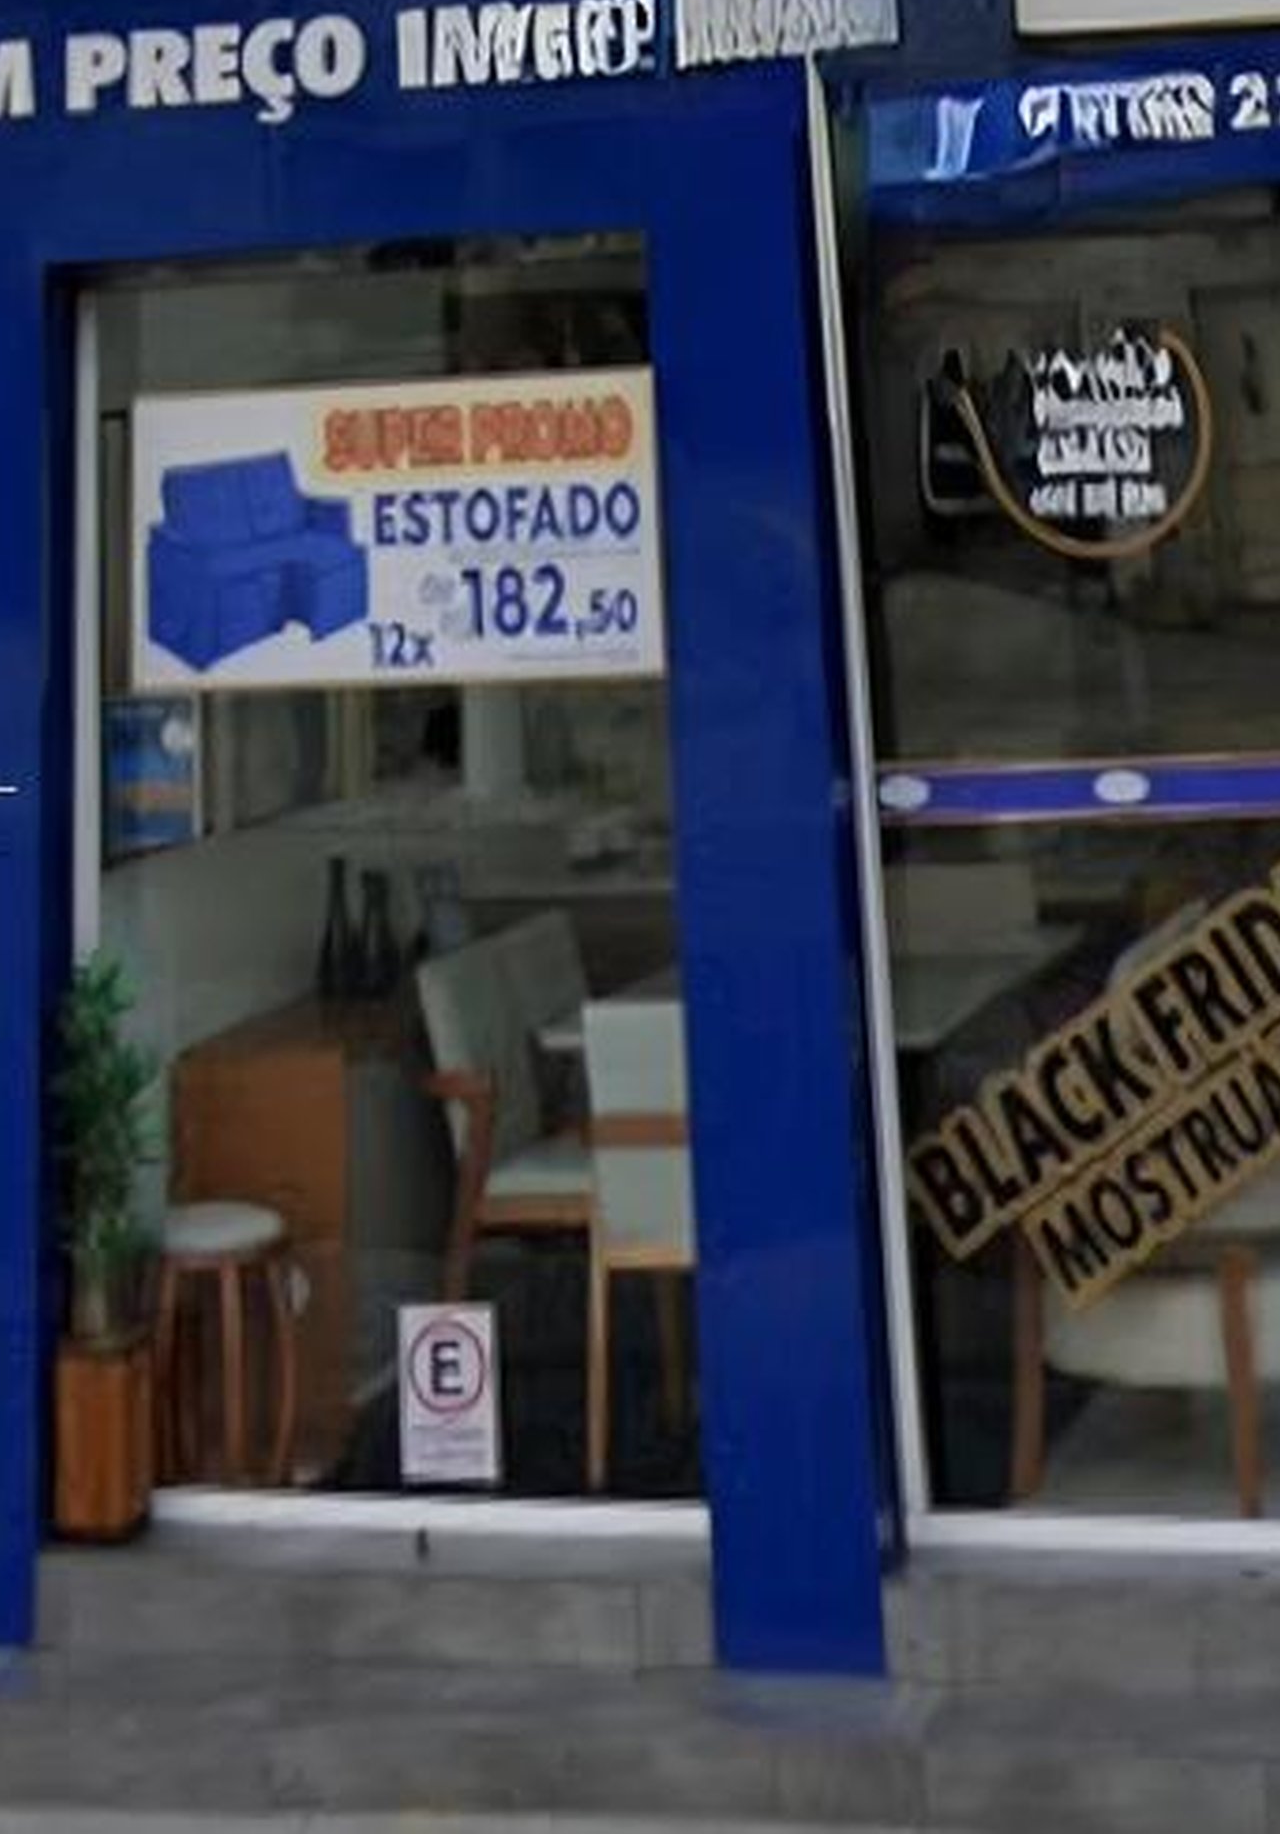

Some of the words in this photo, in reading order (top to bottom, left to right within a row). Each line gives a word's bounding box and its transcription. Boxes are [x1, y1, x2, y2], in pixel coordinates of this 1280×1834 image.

[65, 14, 366, 124] PREÇO
[372, 482, 641, 547] ESTOFADO
[912, 1009, 1153, 1242] BLACK
[430, 1339, 464, 1396] E
